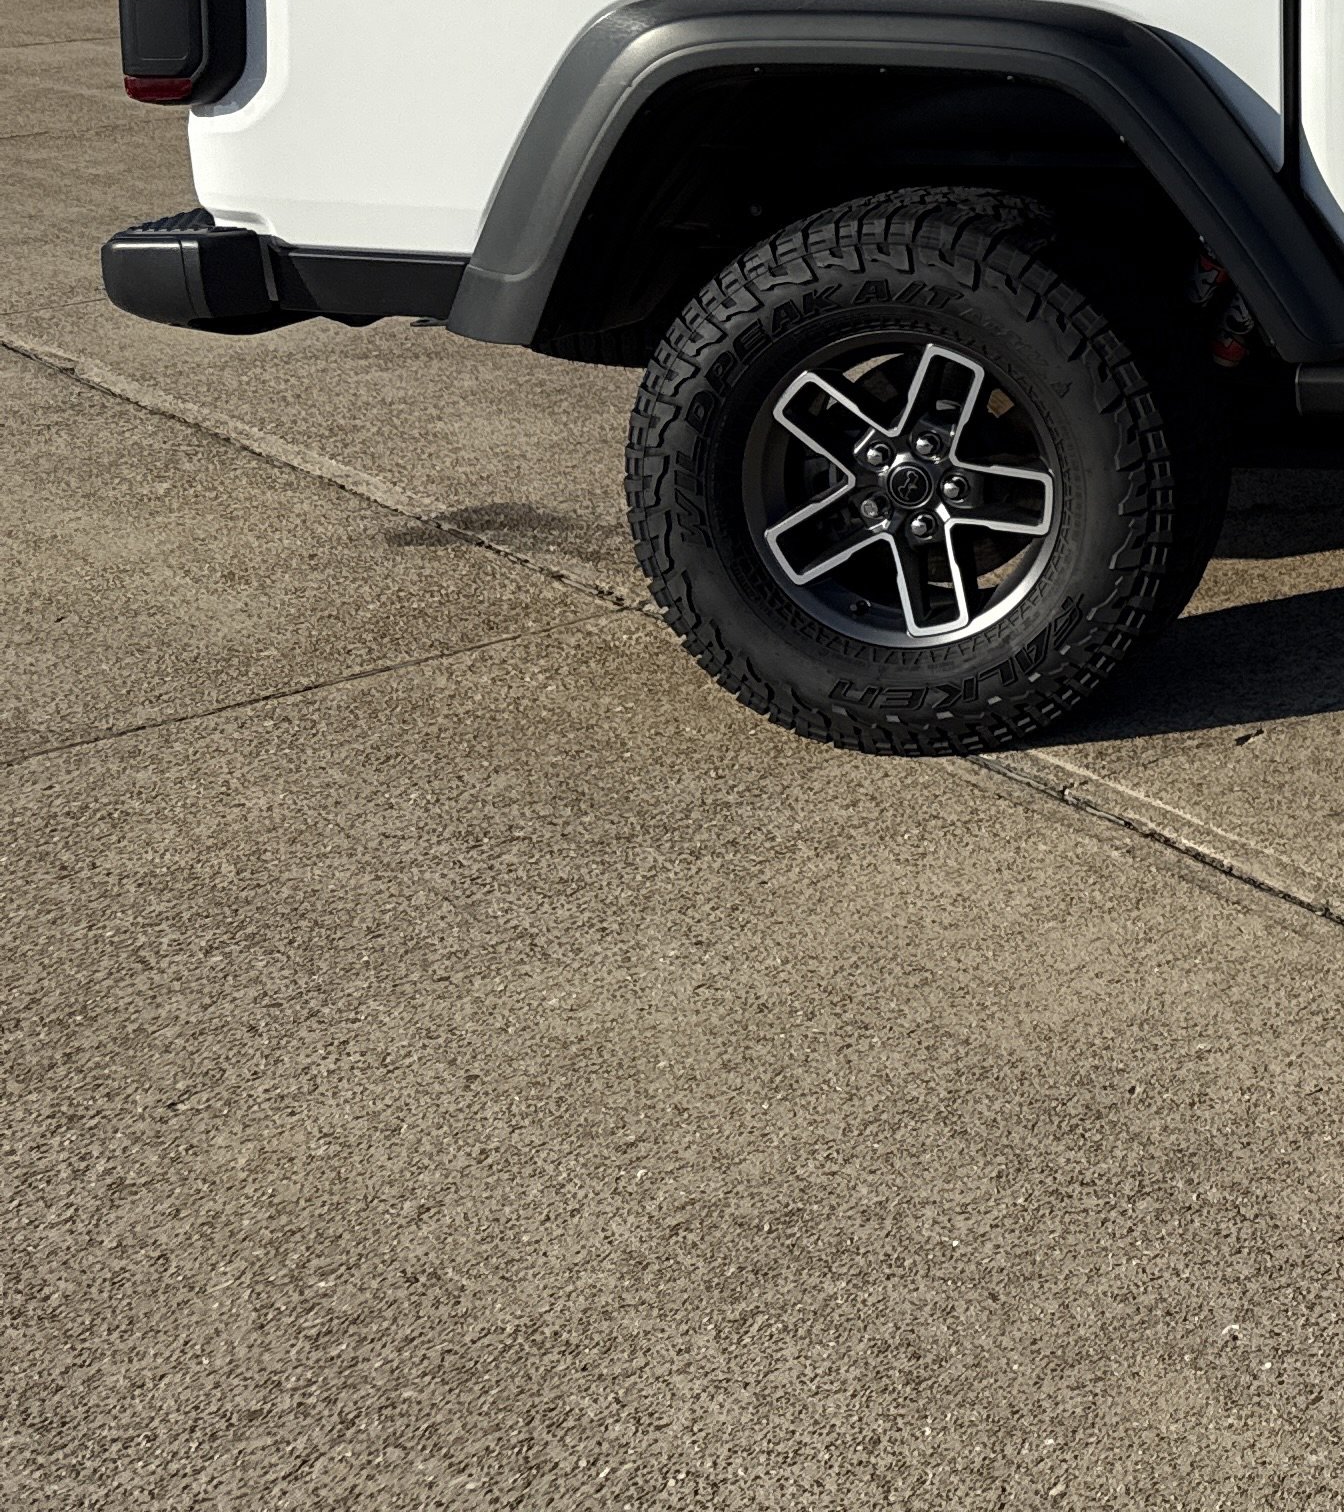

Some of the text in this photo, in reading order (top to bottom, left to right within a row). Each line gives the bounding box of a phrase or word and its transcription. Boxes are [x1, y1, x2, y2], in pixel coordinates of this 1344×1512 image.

[675, 284, 843, 548] WILDPEAK
[853, 278, 965, 310] A/T
[828, 593, 1085, 712] FALKEN
